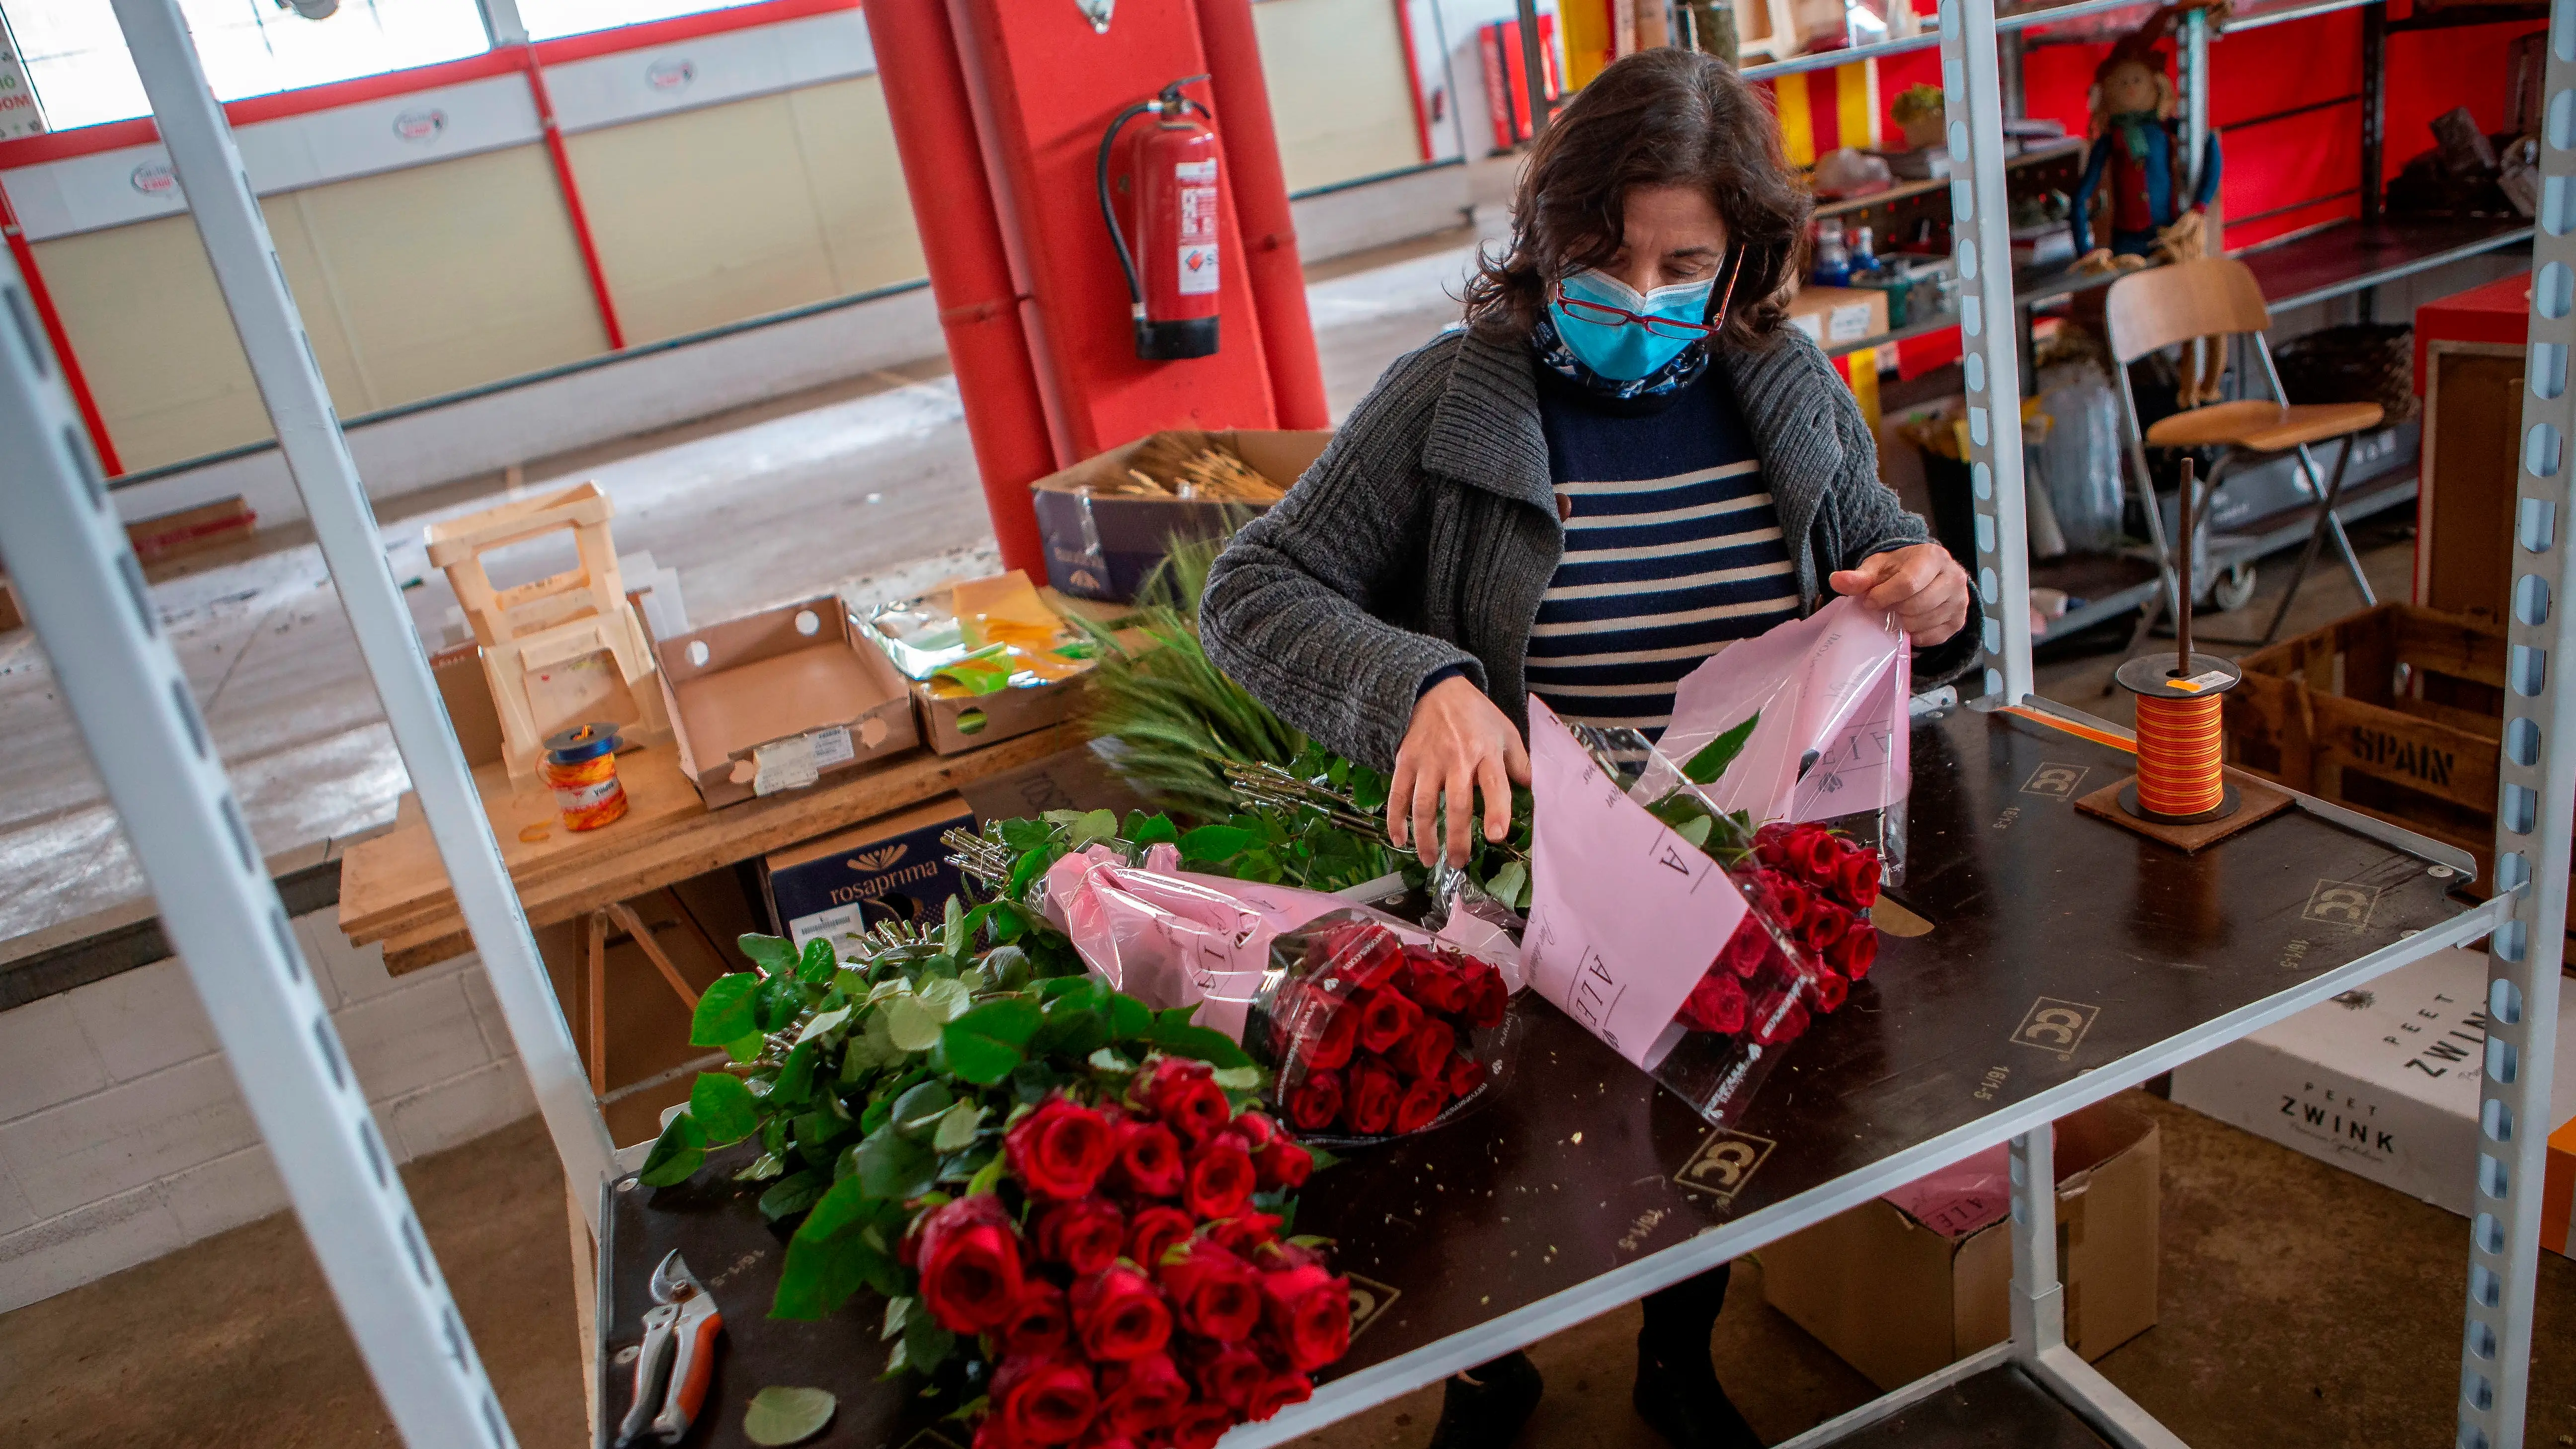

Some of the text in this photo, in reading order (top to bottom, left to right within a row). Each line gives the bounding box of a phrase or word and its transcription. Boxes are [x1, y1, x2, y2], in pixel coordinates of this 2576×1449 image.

[2352, 725, 2454, 786] SPAIN
[830, 861, 938, 904] rosaprima
[2382, 992, 2455, 1046] PEET
[2403, 999, 2486, 1079] ZWIN
[2280, 1094, 2395, 1154] ZWINK
[2304, 1081, 2378, 1117] PEET
